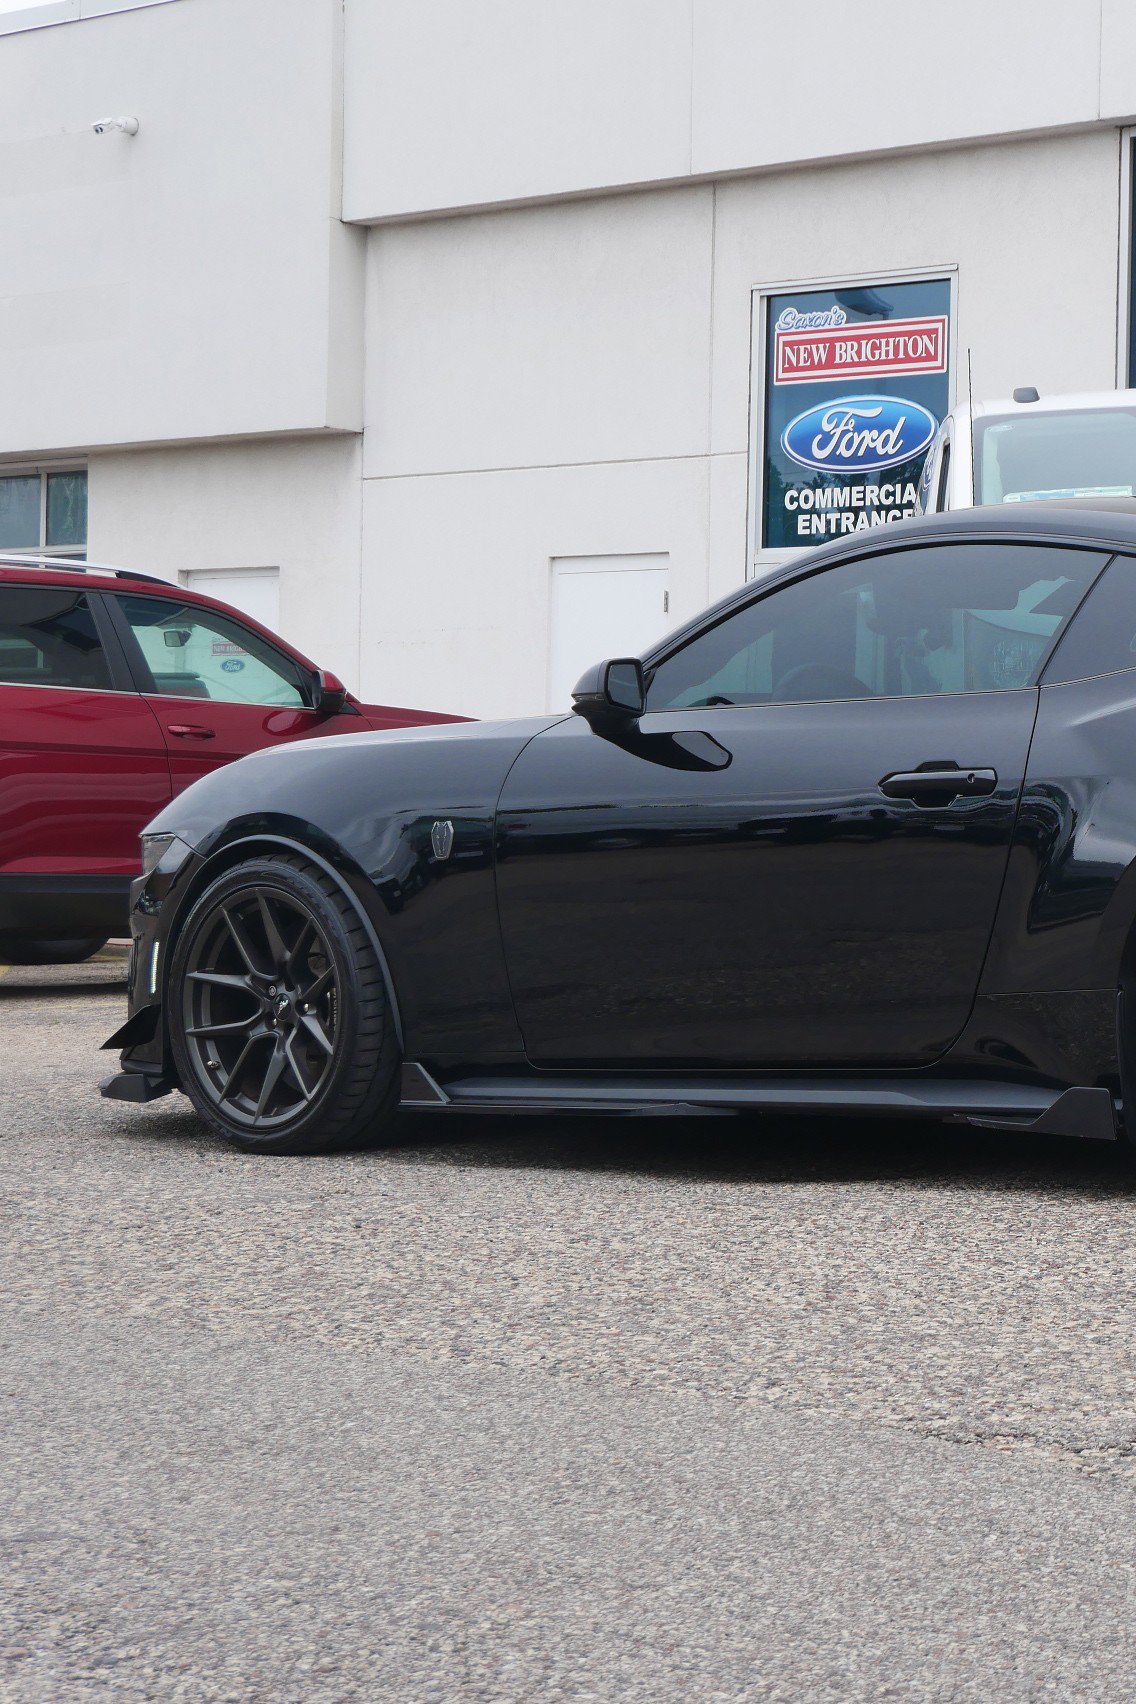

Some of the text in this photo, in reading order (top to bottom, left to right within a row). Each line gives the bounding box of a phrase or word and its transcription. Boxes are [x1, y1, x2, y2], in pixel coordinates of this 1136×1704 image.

[777, 306, 845, 331] Saxon's
[784, 334, 937, 368] NEW BRIGHTON
[812, 405, 907, 459] Ford
[784, 482, 917, 511] COMMERCIA
